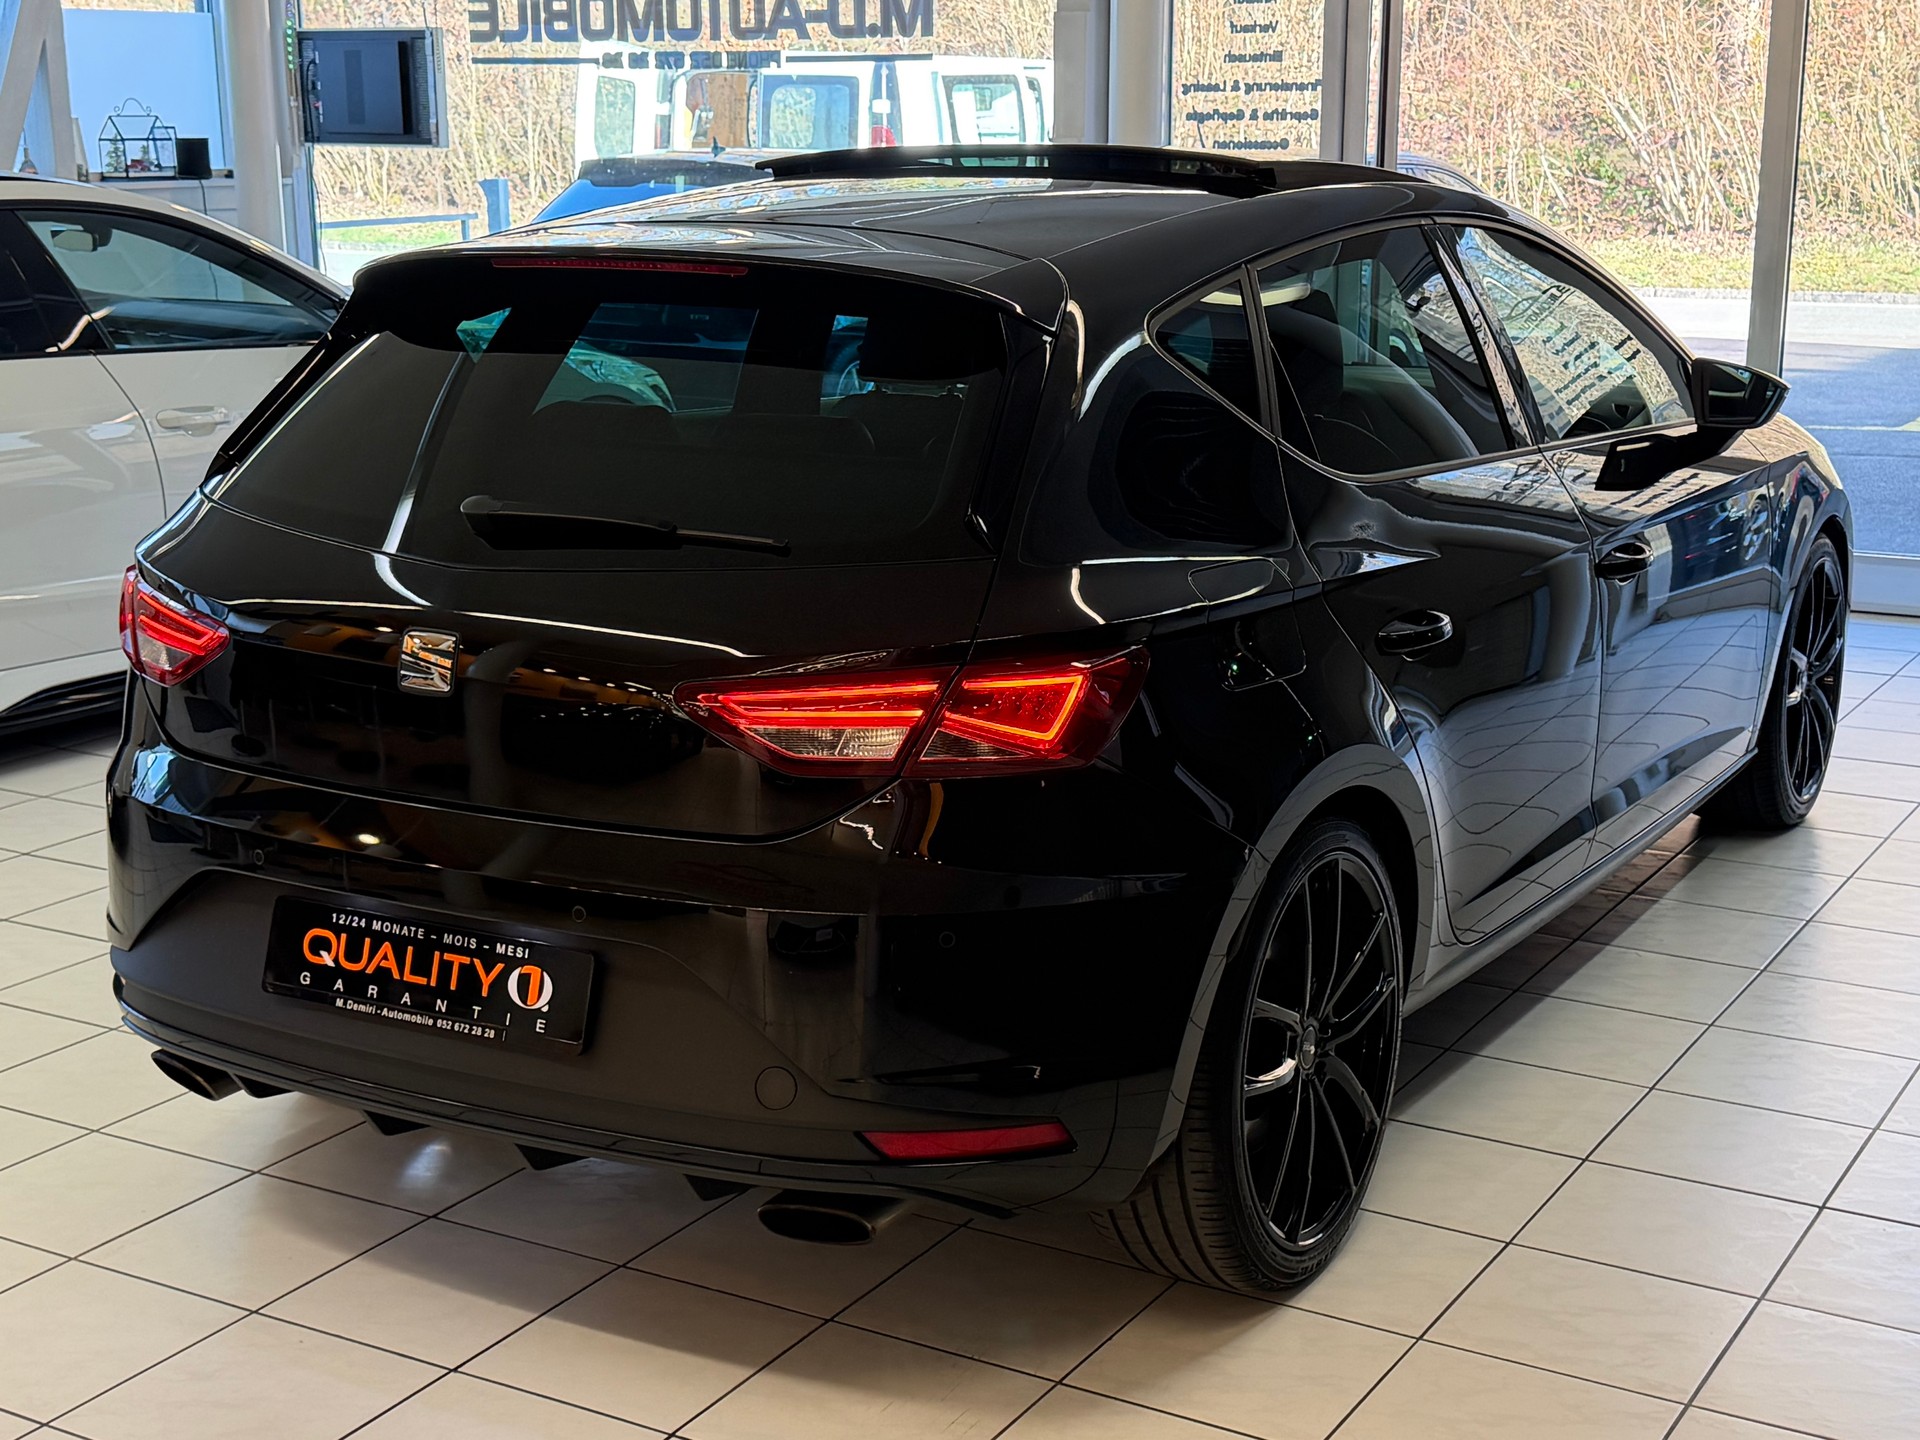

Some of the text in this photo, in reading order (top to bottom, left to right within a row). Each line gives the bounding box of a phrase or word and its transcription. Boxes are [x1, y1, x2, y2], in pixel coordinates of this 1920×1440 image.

[303, 928, 505, 997] QUALITY
[331, 912, 366, 928] 12/24
[372, 919, 425, 939] MONATE
[443, 932, 477, 949] MOIS
[496, 943, 530, 959] MESI
[300, 972, 546, 1034] GARANTIE
[436, 1019, 452, 1030] 052
[454, 1022, 470, 1033] 672
[471, 1026, 482, 1036] 28
